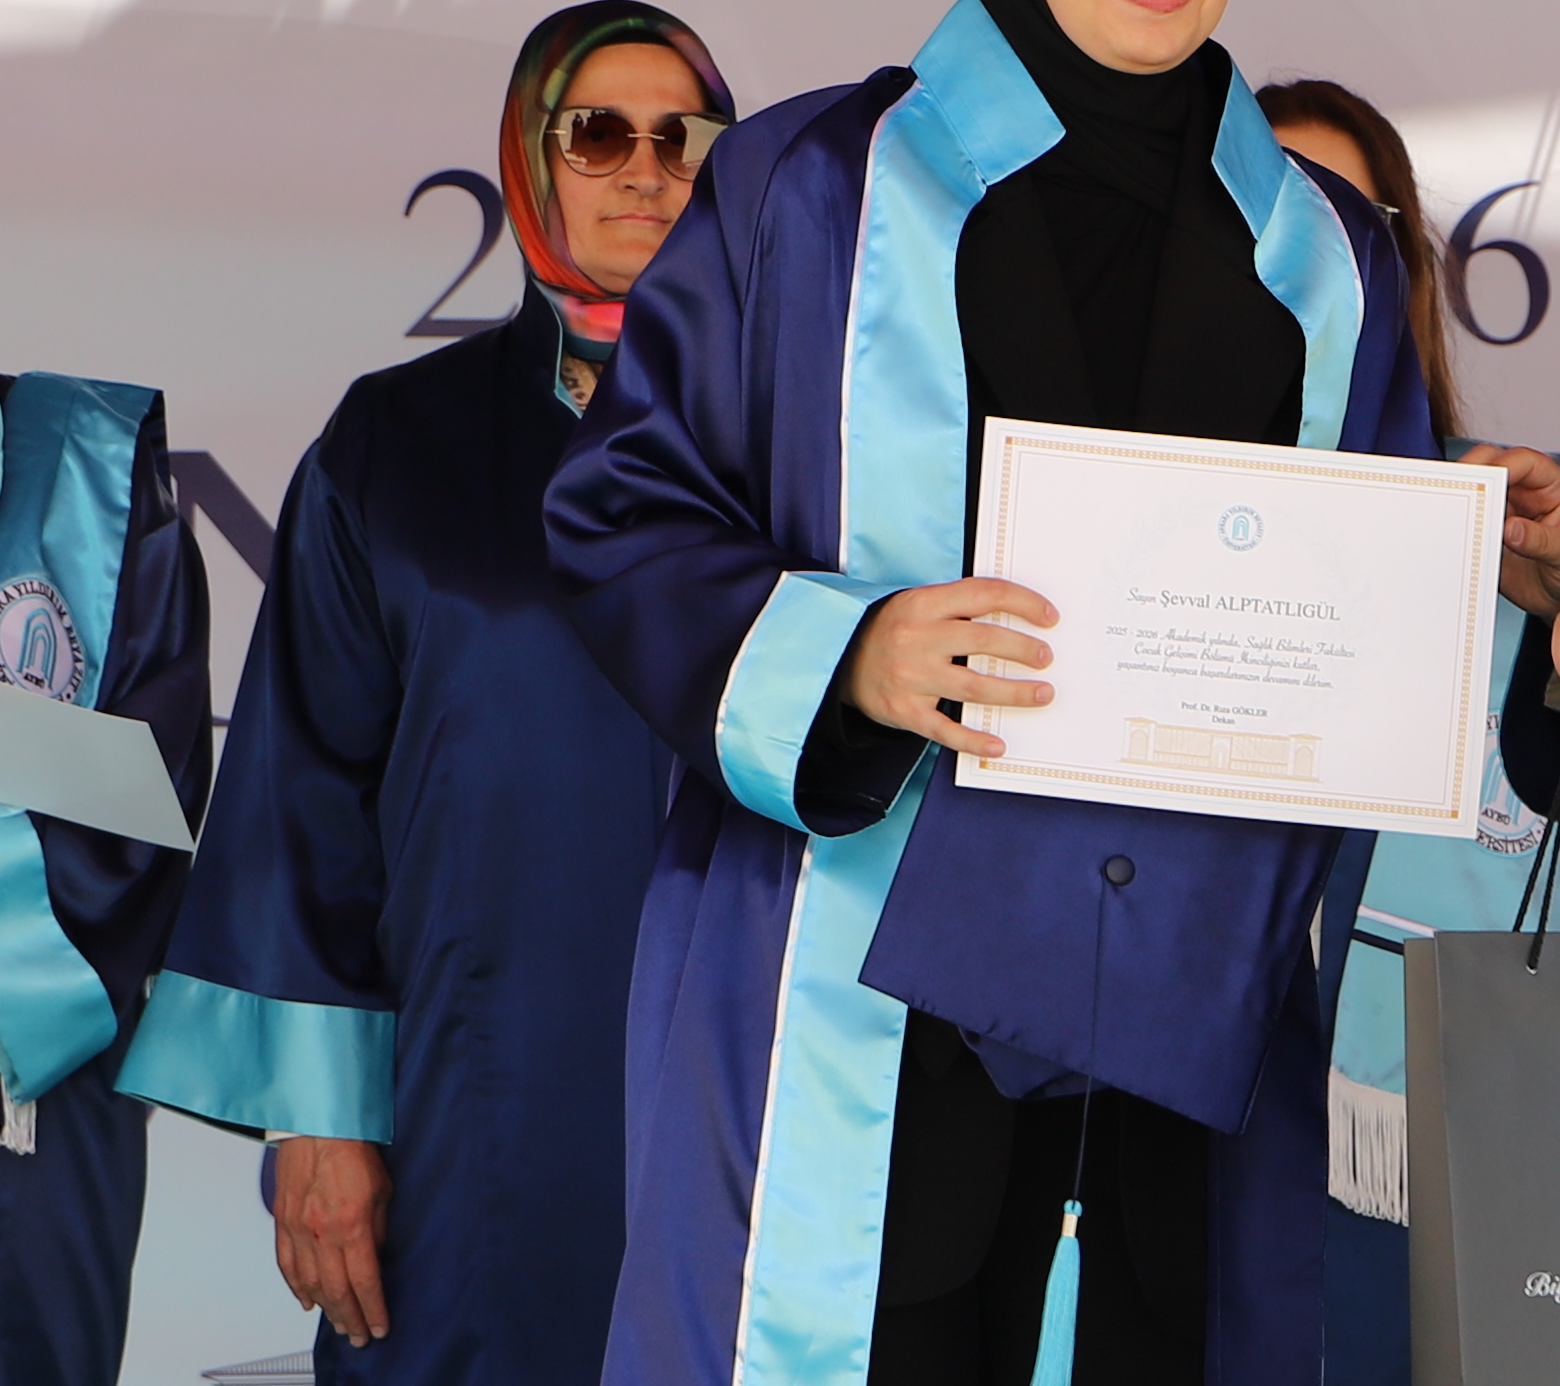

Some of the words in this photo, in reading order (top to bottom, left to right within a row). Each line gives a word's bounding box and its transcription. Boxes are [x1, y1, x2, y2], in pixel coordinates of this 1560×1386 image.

[1159, 589, 1211, 609] Şevval
[1215, 596, 1341, 621] ALPTATLIGÜL
[1481, 807, 1512, 826] AYBÜ
[1475, 828, 1539, 855] ERSİTESİ
